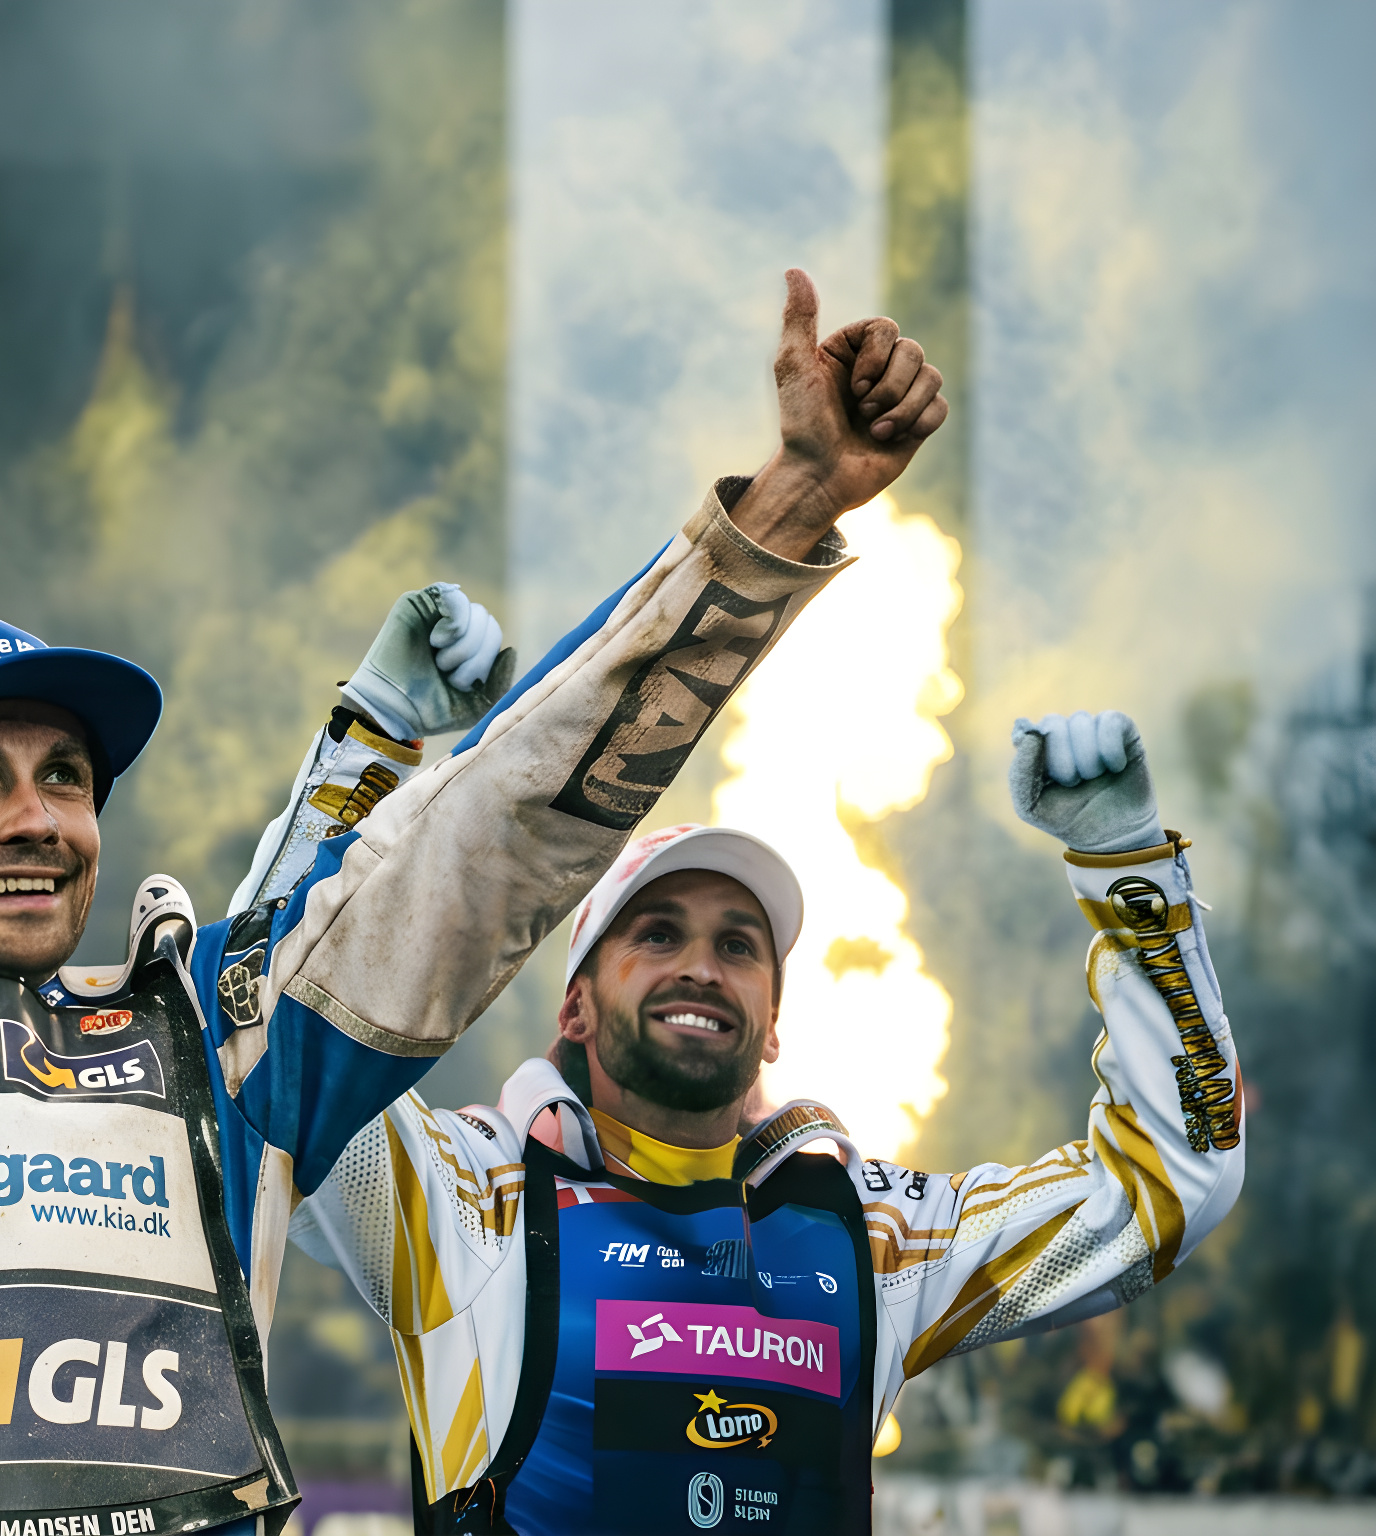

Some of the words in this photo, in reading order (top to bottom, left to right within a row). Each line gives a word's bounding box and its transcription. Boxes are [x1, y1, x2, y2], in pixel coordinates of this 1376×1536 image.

[78, 1058, 145, 1089] GLS
[31, 1204, 171, 1238] www.kia.dk
[599, 1243, 650, 1262] FIM
[687, 1325, 823, 1372] TAURON
[28, 1338, 182, 1431] GLS
[0, 1514, 101, 1536] MADSEN
[110, 1507, 156, 1536] DEN
